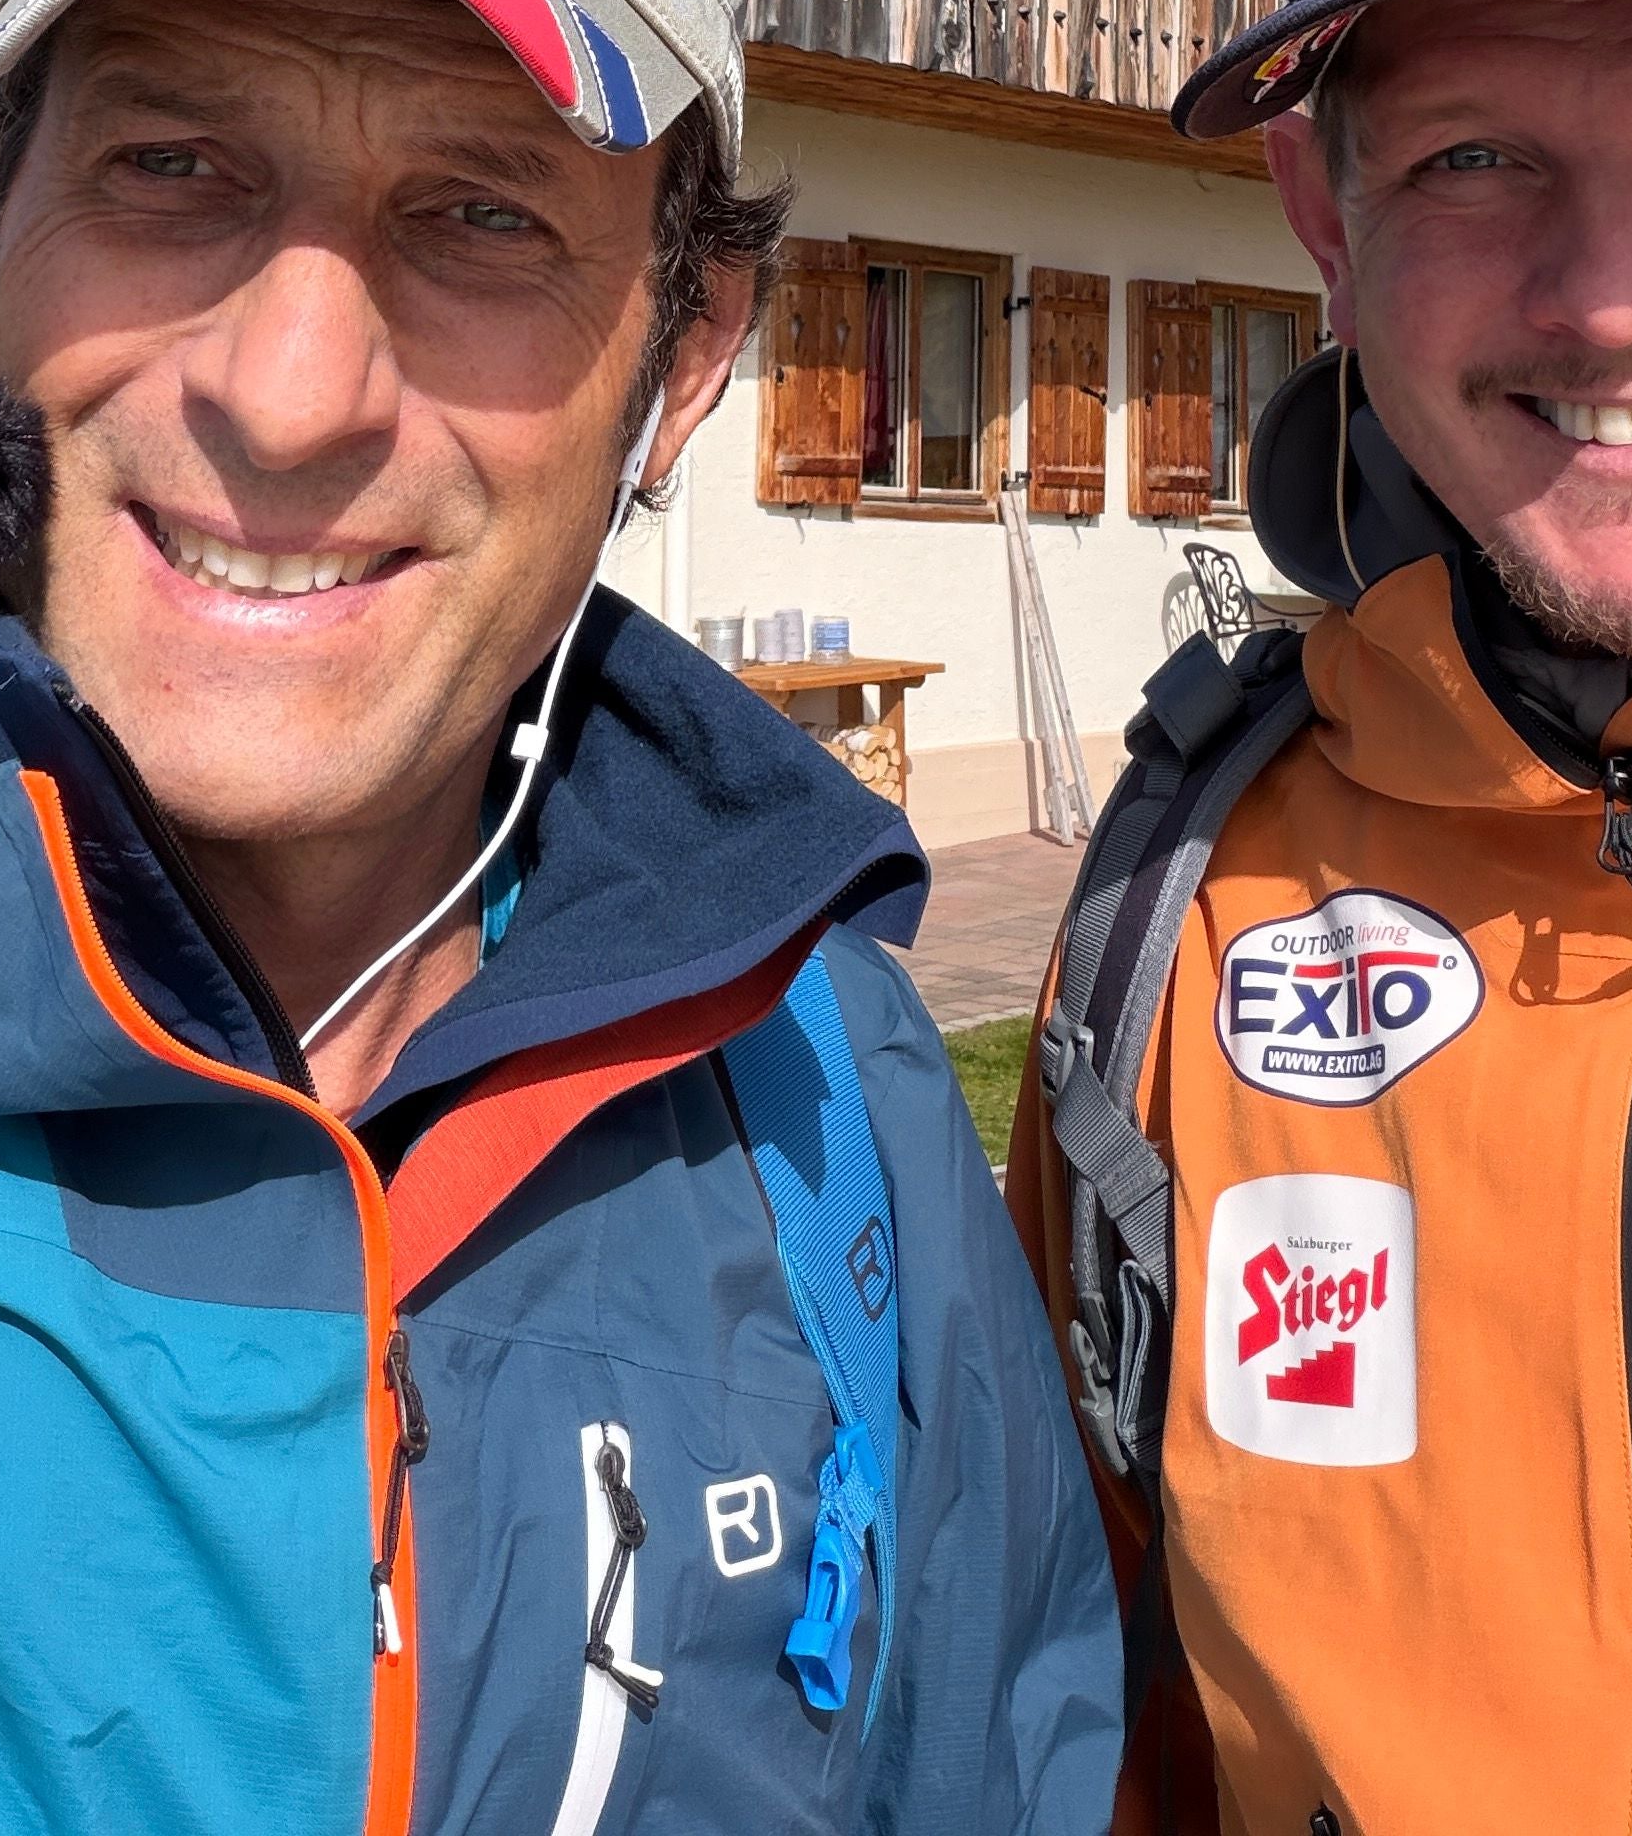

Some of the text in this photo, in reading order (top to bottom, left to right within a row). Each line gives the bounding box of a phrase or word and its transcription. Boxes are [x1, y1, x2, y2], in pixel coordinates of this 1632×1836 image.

[1270, 921, 1410, 956] OUTDOOR living
[1267, 1049, 1383, 1075] WWW.EXITO.AG
[1286, 1235, 1353, 1254] Salzburger
[1238, 1242, 1389, 1367] Stiegl
